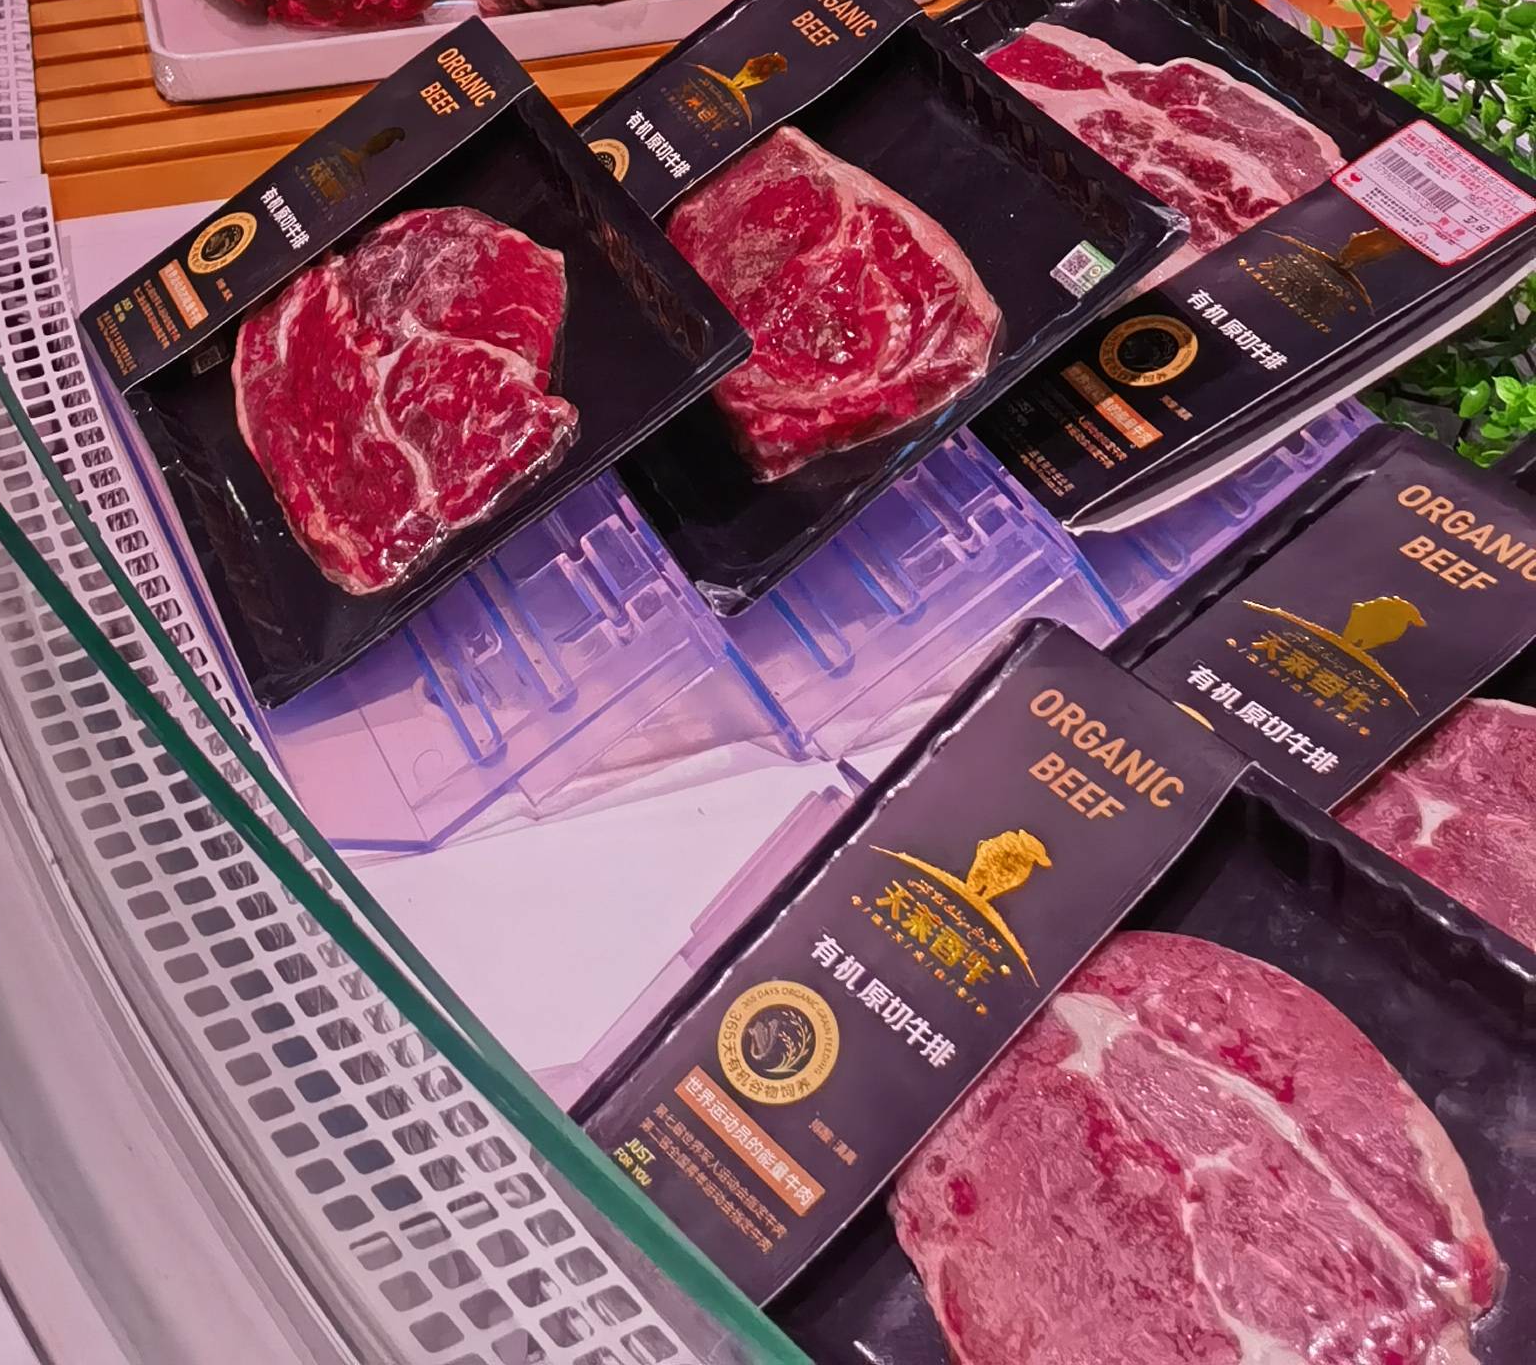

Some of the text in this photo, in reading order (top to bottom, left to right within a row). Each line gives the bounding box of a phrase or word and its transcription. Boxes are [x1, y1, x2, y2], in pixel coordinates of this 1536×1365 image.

[792, 9, 839, 48] BEEF
[419, 80, 462, 117] BEEF
[436, 45, 498, 110] ORGANIC
[1186, 289, 1290, 372] 有机原切牛排
[1395, 482, 1536, 585] ORGANIC
[1398, 533, 1498, 597] BEEF
[1028, 687, 1186, 812] ORGANIC
[1184, 662, 1341, 776] 有机原切牛排
[1027, 751, 1127, 828] BEEF
[809, 931, 959, 1071] 有机原切牛排
[612, 1146, 653, 1187] FOR YOU
[623, 1137, 656, 1164] JUST
[682, 1074, 815, 1207] 世界运动员的能量牛肉
